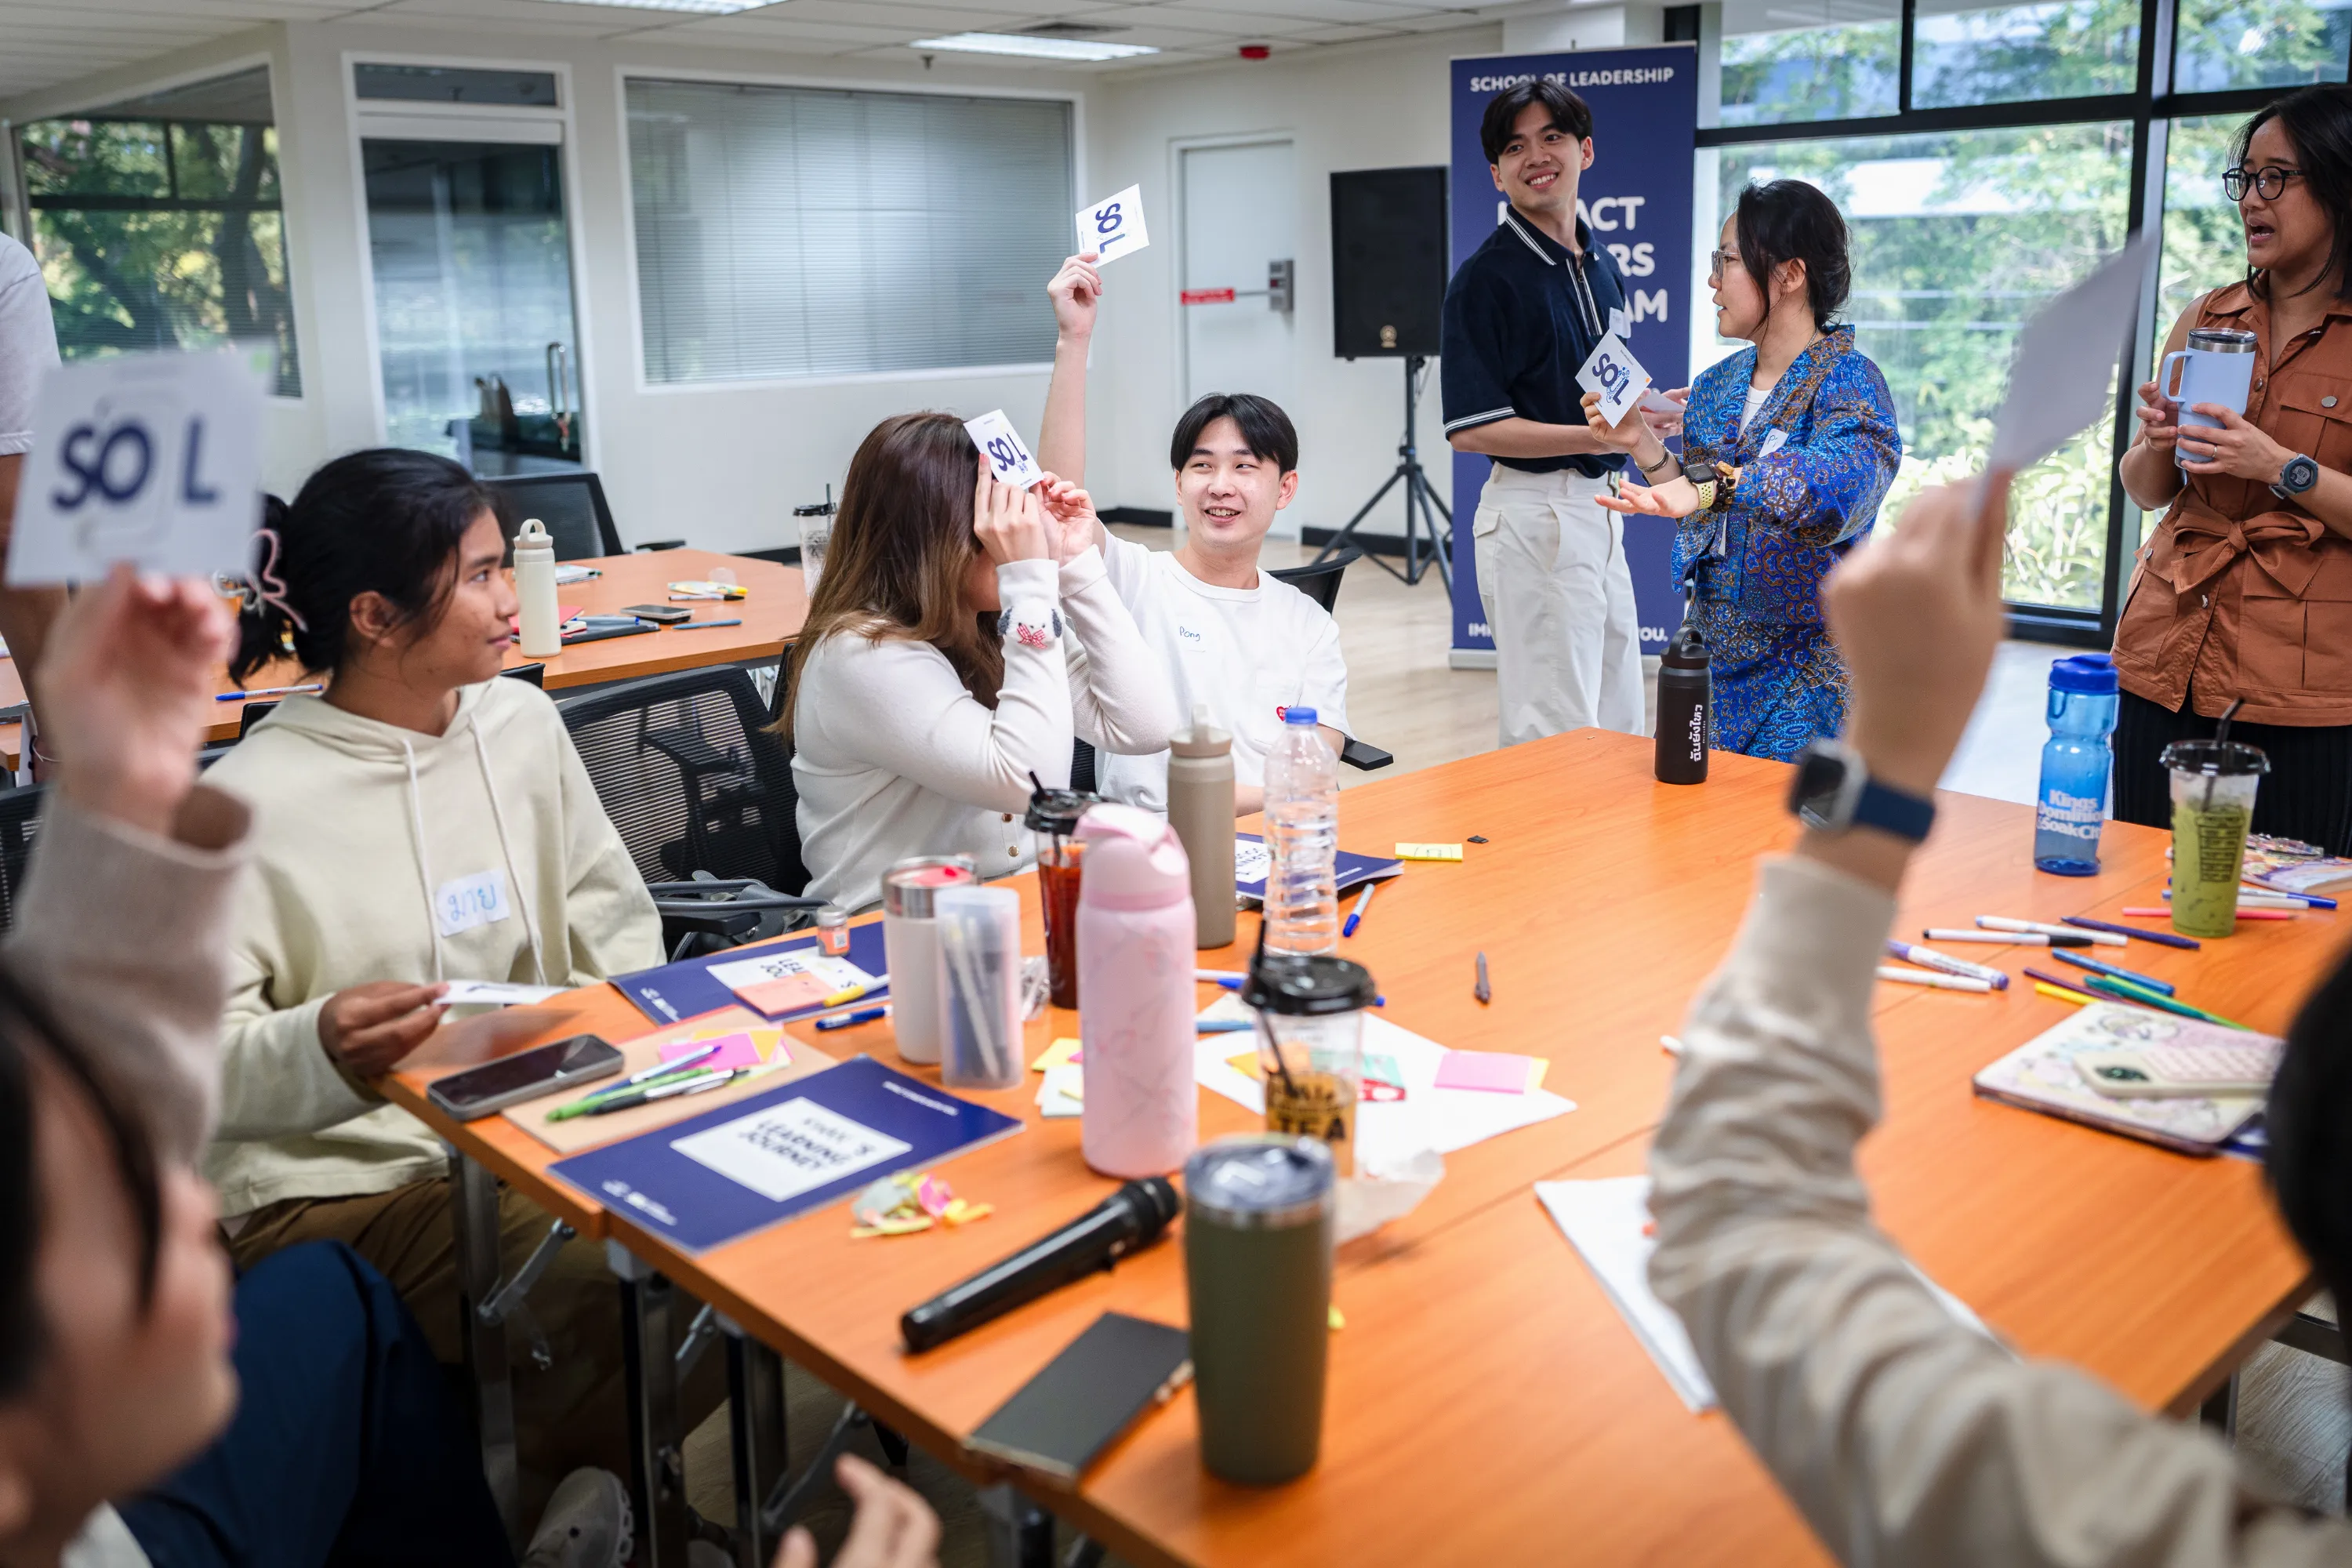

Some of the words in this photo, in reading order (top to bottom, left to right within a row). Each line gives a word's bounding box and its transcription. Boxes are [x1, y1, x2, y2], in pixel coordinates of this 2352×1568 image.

[1570, 67, 1674, 87] LEADERSHIP
[1180, 626, 1200, 641] Pong
[1638, 626, 1669, 642] OU.
[1689, 704, 1703, 762] ฉันยังไหว
[2049, 789, 2098, 811] Kings
[2038, 800, 2103, 823] Dominio
